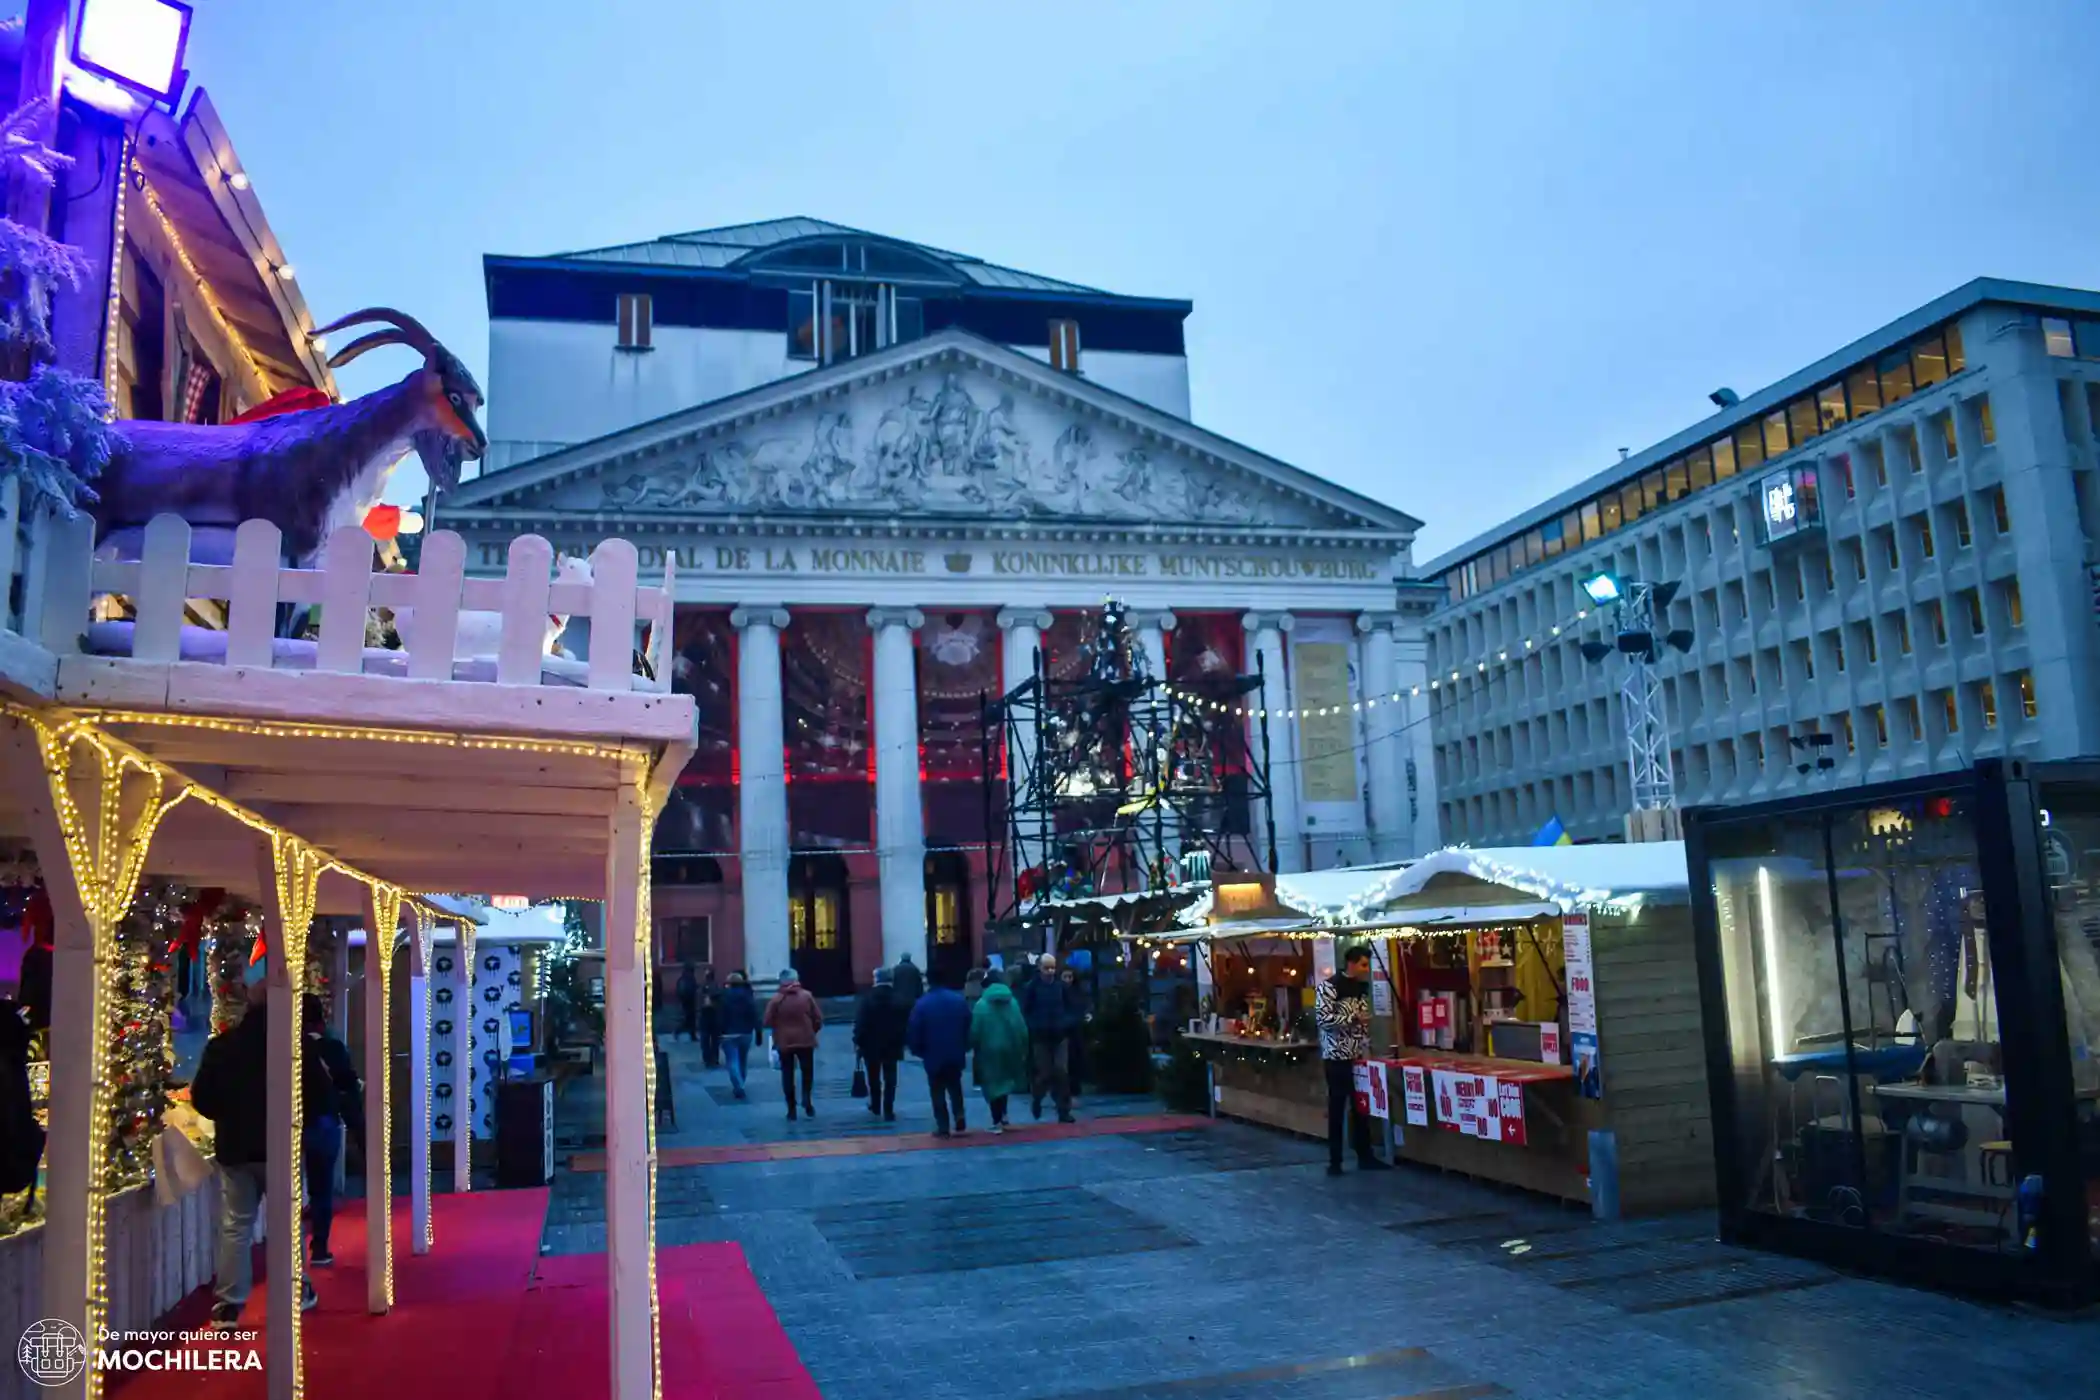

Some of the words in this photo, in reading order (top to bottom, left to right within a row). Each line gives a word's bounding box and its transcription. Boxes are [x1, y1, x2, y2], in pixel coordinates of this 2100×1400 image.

[715, 550, 751, 571] DE
[764, 549, 798, 571] LA
[811, 550, 926, 573] MONNAIE
[992, 551, 1147, 576] KONINKLIJKE
[1158, 555, 1377, 579] MUNTSCHOUWBURG
